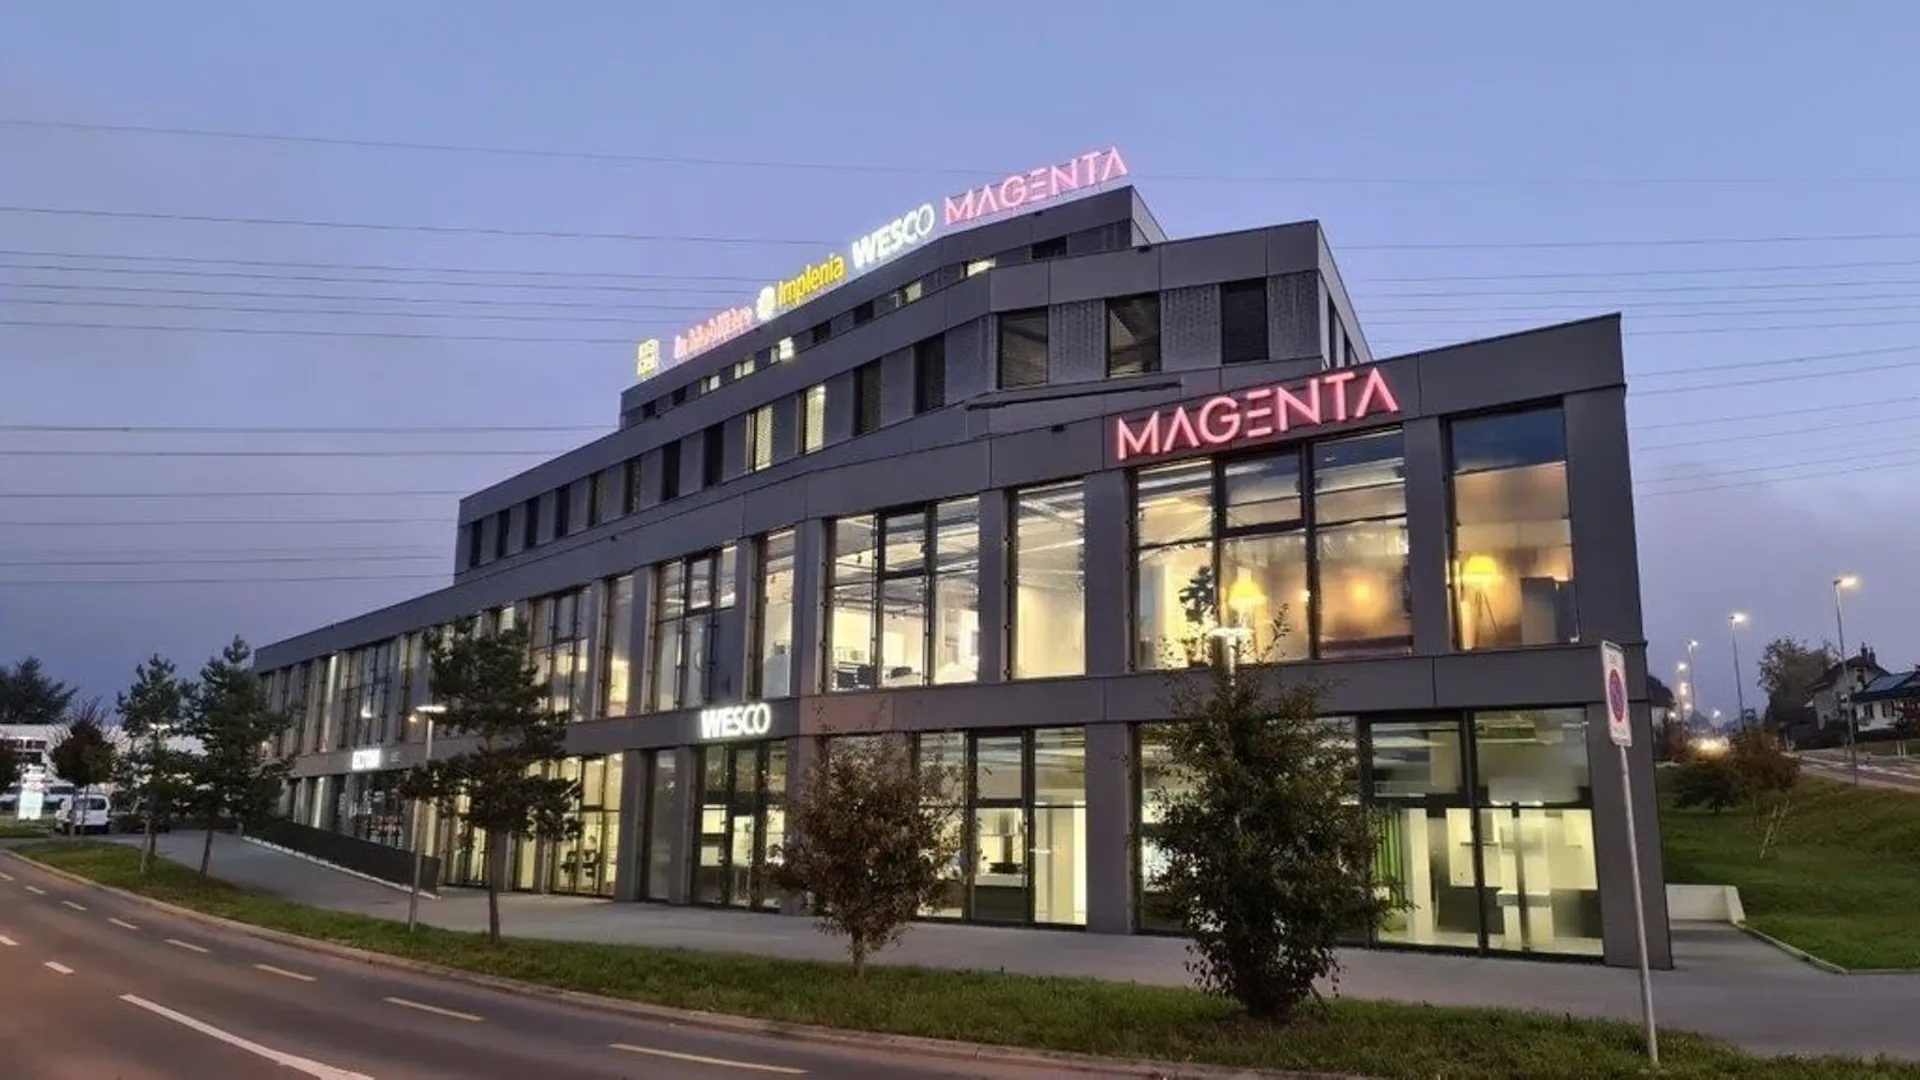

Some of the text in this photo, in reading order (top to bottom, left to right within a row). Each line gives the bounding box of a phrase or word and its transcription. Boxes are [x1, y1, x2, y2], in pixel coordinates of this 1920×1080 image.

[945, 146, 1128, 225] MAGENTA
[852, 203, 935, 269] WESCO
[778, 253, 845, 308] Implenia
[1118, 367, 1398, 460] MAGENTA
[701, 703, 771, 739] WESCO
